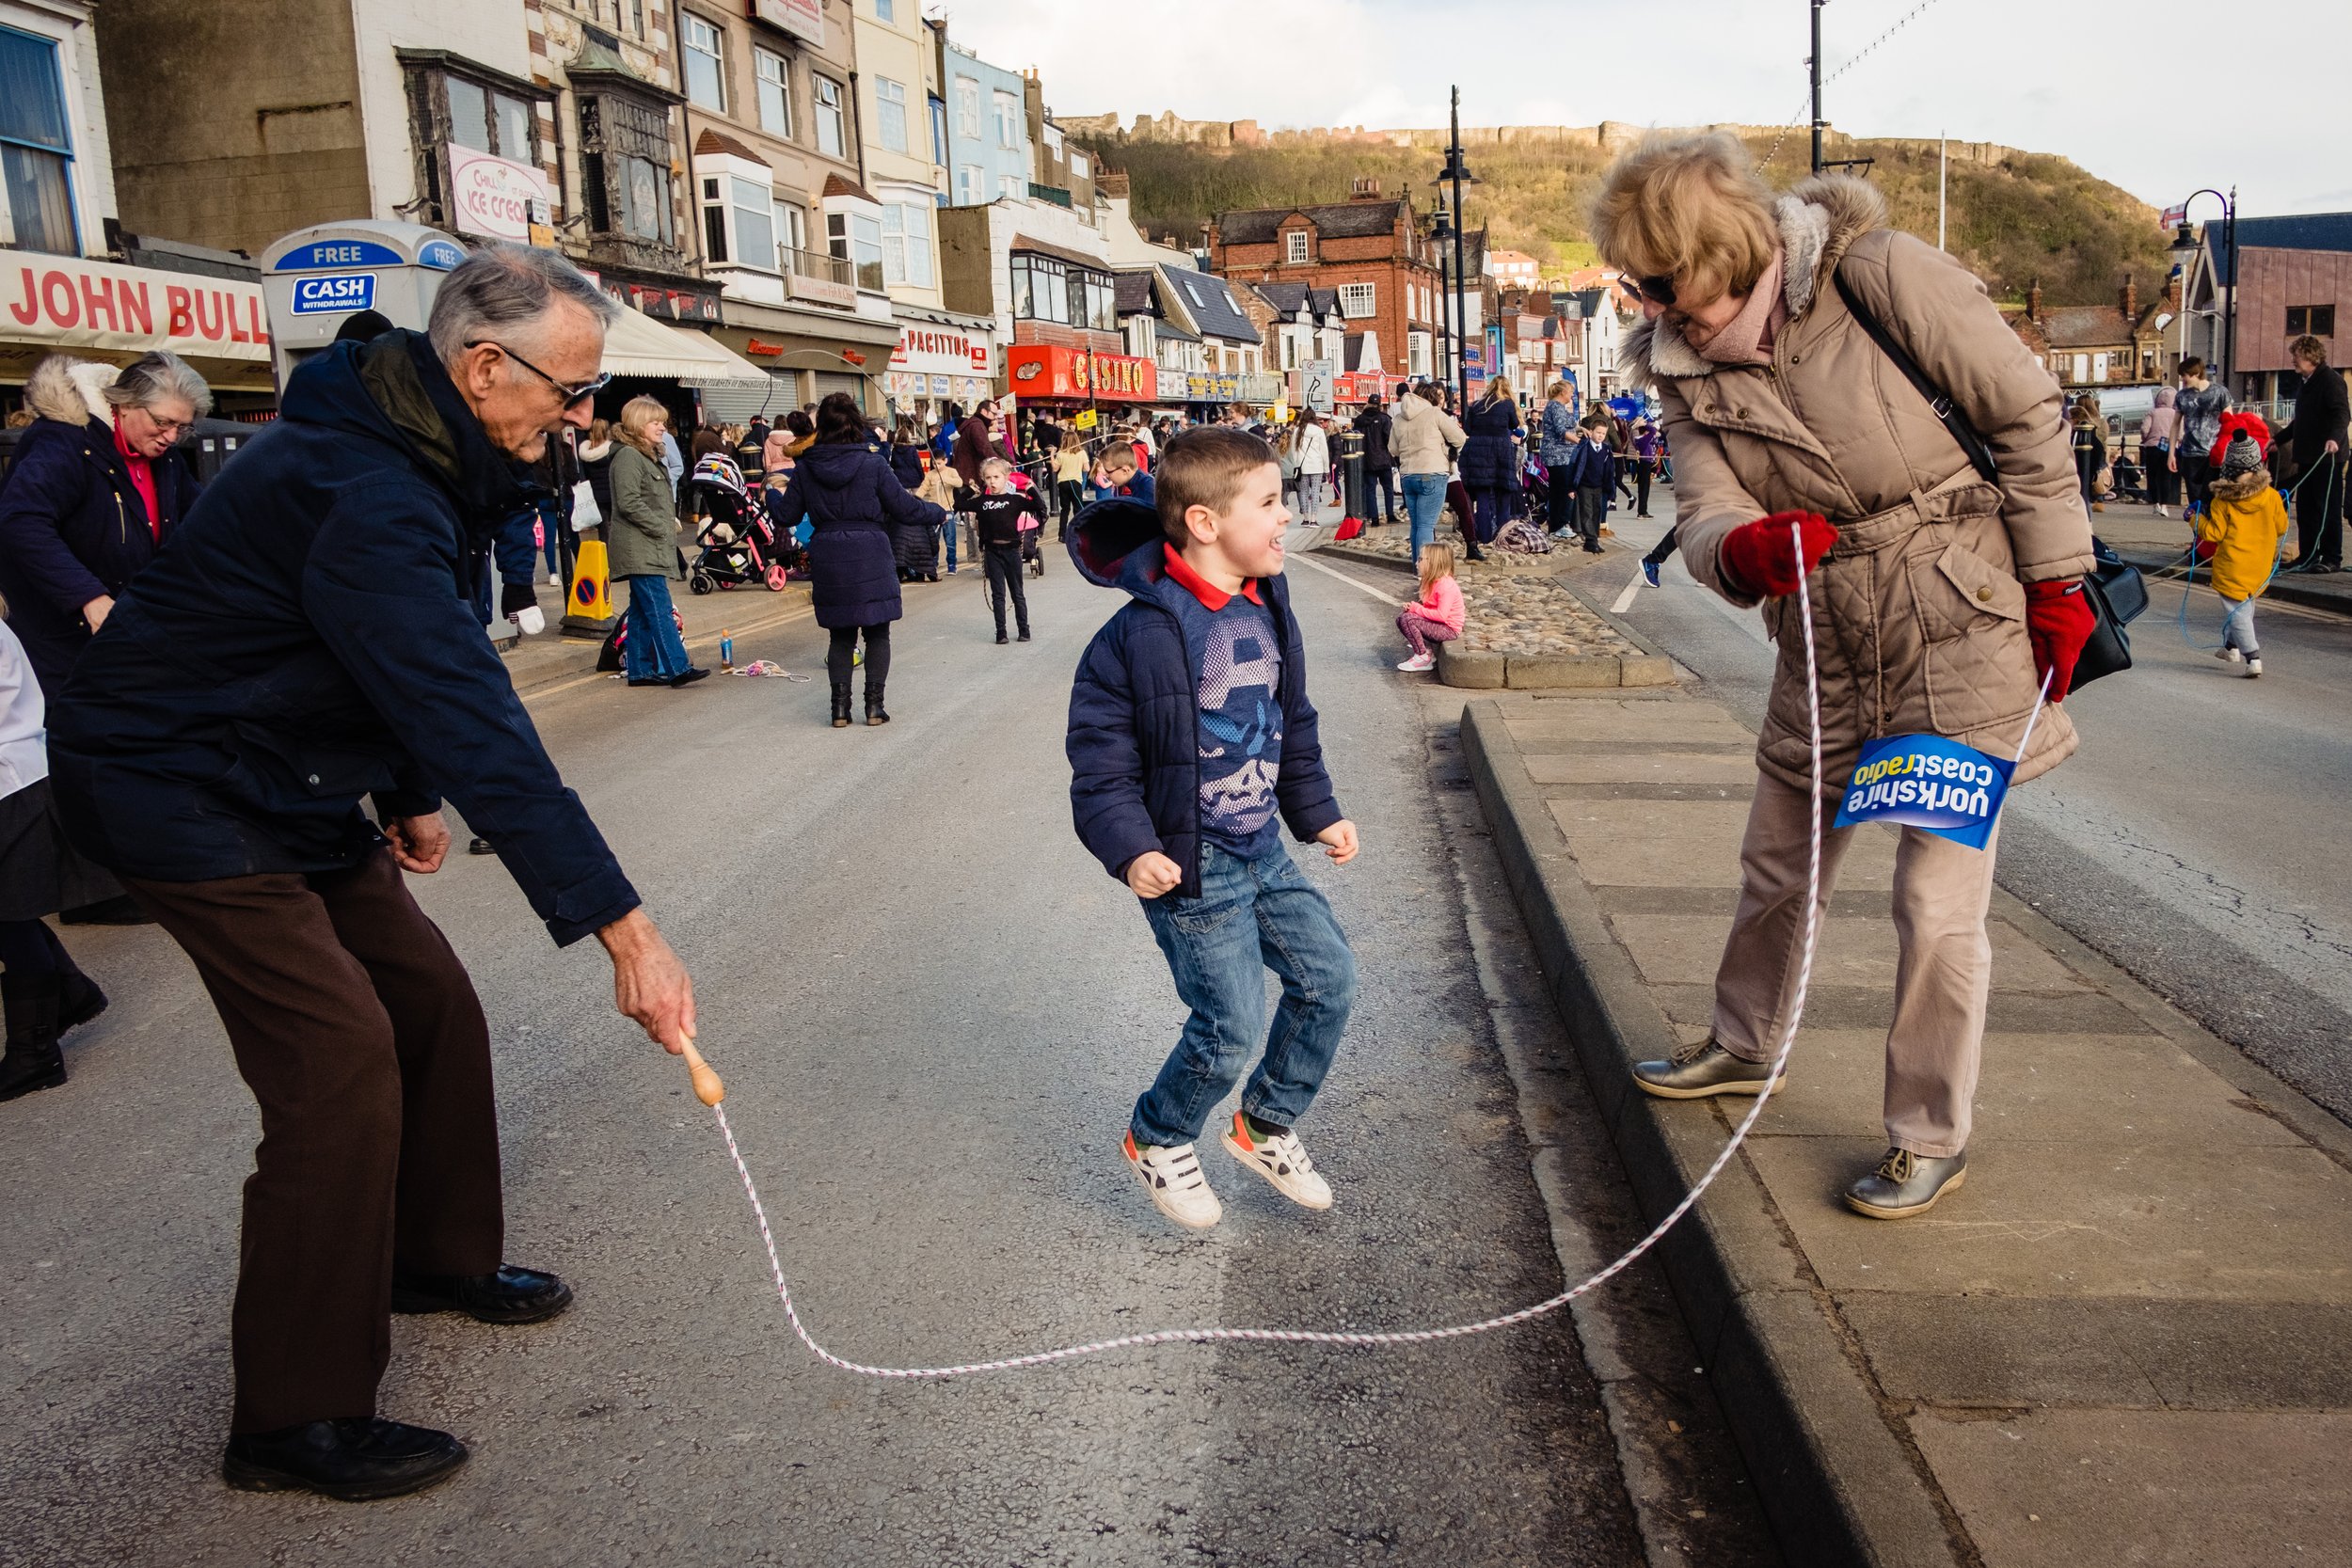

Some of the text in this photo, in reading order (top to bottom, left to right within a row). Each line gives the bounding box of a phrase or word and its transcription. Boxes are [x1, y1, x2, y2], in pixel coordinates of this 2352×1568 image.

[467, 189, 487, 215] ICE
[313, 245, 362, 263] FREE
[434, 247, 456, 265] FREE
[302, 278, 365, 299] CASH
[9, 267, 270, 344] JOHN BULL
[302, 298, 362, 309] WITHDRAWALS
[908, 329, 970, 357] PACITTOS
[1073, 353, 1144, 396] CASINO
[1847, 780, 1990, 817] yorkshire
